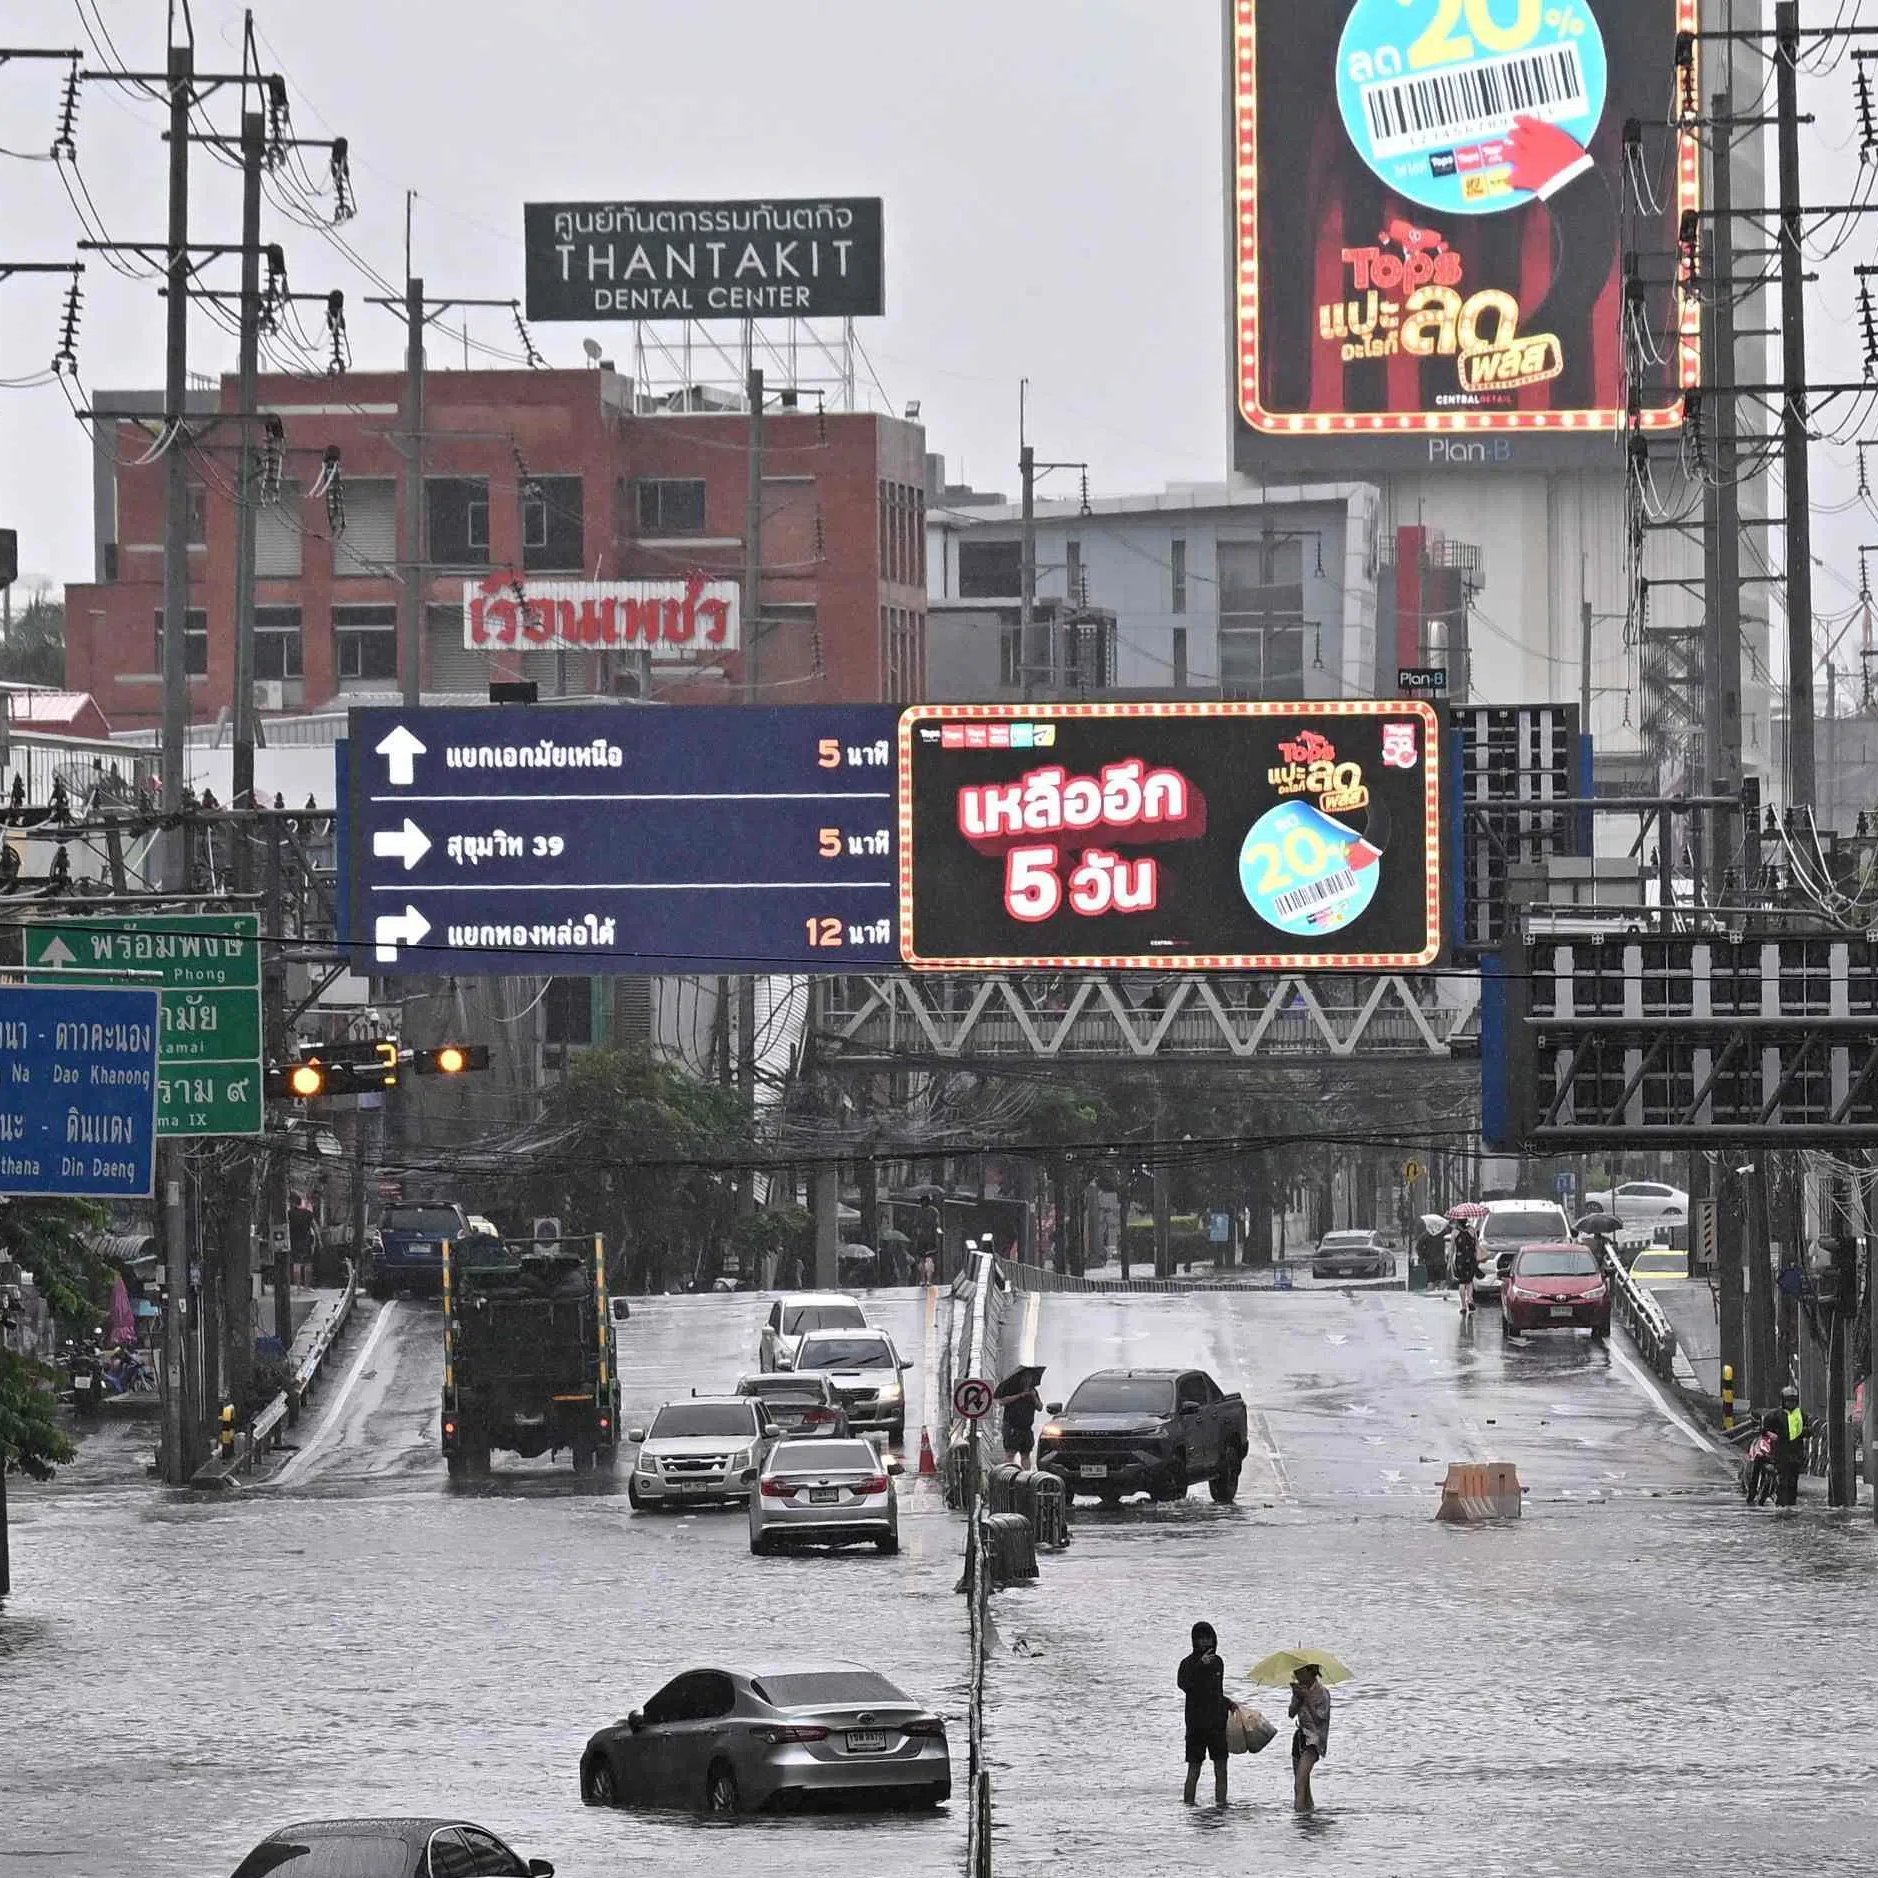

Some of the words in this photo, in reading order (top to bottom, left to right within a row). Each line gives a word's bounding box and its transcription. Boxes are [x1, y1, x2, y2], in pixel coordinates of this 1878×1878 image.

[1347, 45, 1403, 83] ลด
[554, 204, 853, 242] ศูนย์ทันตกรรมทันตกิจ
[555, 239, 853, 281] THANTAKIT
[1341, 247, 1463, 294] Tops
[594, 288, 694, 311] DENTAL
[708, 285, 811, 309] CENTER
[1400, 285, 1519, 355] ลด
[1435, 394, 1480, 405] CENTRAL
[446, 738, 623, 769] แยกเอกมัยเหนือ
[818, 739, 842, 768] 5
[847, 740, 889, 767] นาที
[961, 761, 1186, 836] เหลืออีก
[447, 828, 523, 866] สุขุมวิท
[531, 835, 565, 857] 39
[819, 828, 842, 857] 5
[848, 829, 890, 856] นาที
[1008, 847, 1059, 919] 5
[1071, 852, 1154, 914] วัน
[90, 920, 246, 960] พร้อมพงษ์
[447, 913, 616, 946] แยกทองหล่อใต้
[806, 917, 843, 947] 12
[849, 918, 891, 945] นาที
[174, 967, 226, 984] Phong
[55, 1022, 151, 1054] ดาวคะนอง
[12, 1063, 31, 1083] Na
[53, 1064, 80, 1084] Dao
[90, 1066, 151, 1092] Khanong
[227, 1077, 250, 1103] ๙
[66, 1106, 133, 1144] ดินแดง
[189, 1113, 207, 1127] IX
[61, 1157, 84, 1177] Din
[92, 1158, 136, 1184] Daeng
